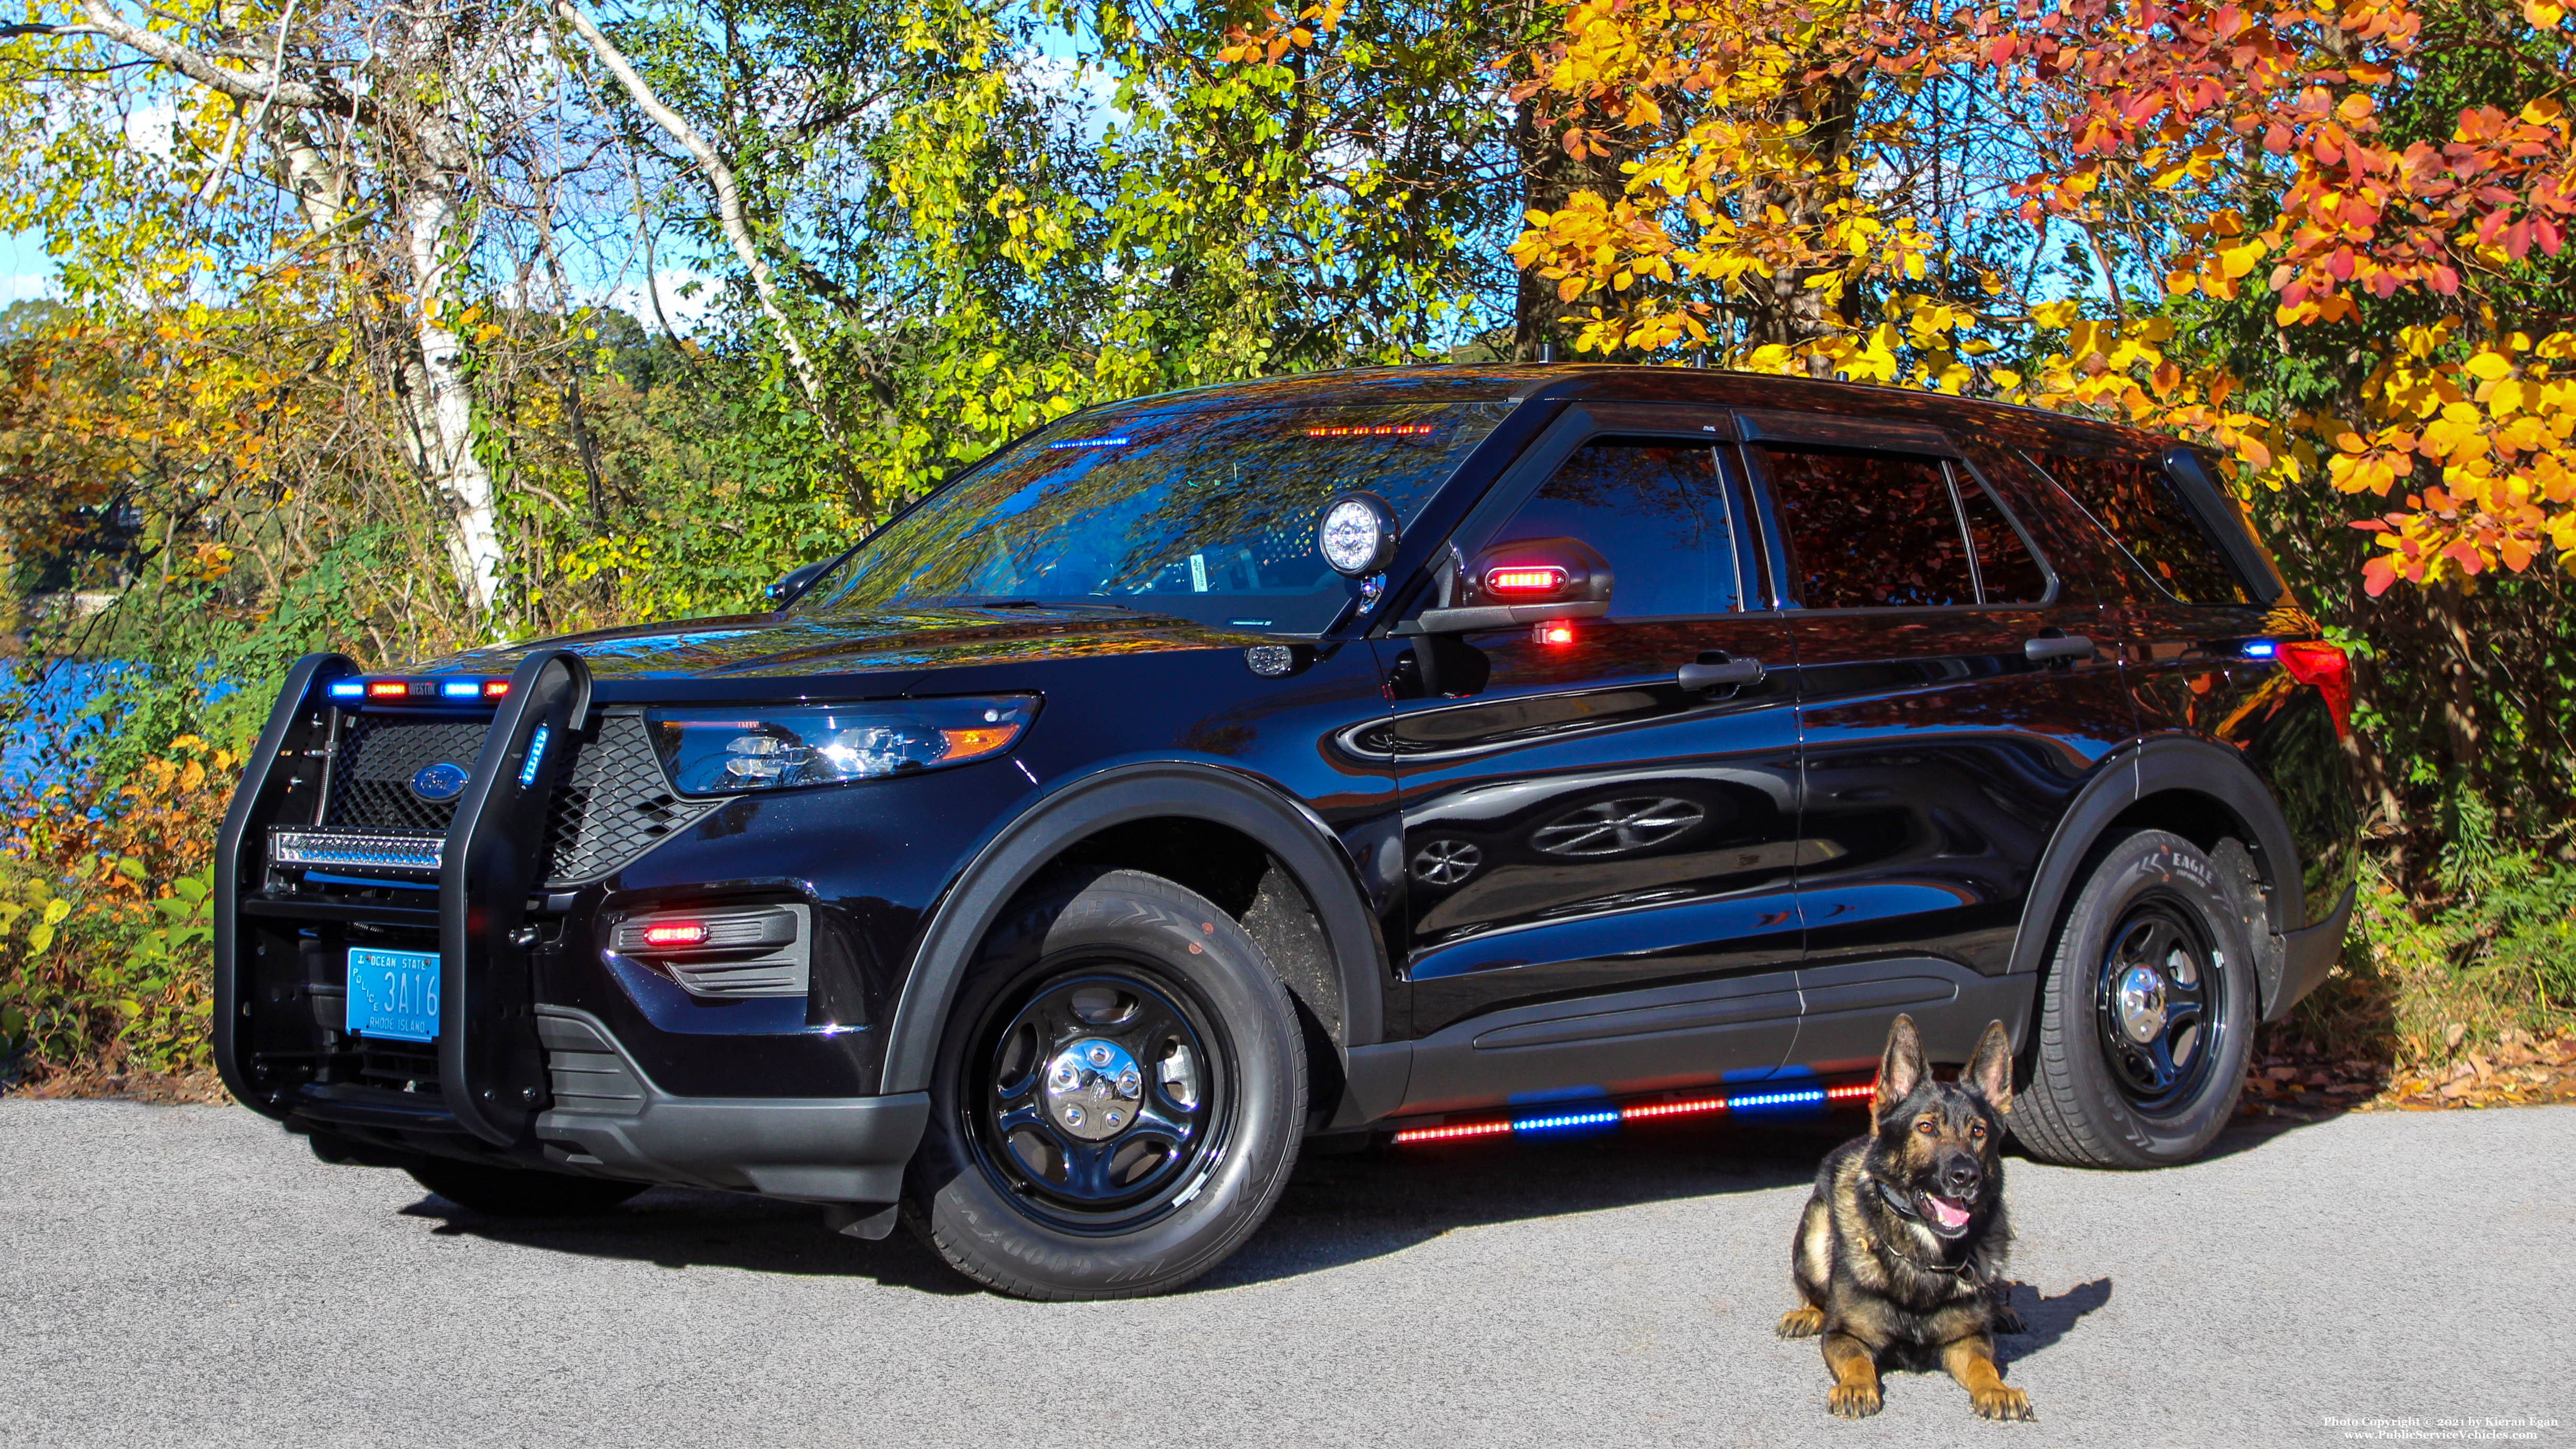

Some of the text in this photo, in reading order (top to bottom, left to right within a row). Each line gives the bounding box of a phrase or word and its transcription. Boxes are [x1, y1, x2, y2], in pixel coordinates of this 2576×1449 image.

[2172, 852, 2214, 885] EAGLE
[370, 956, 426, 971] OCEAN STATE
[353, 968, 380, 1012] POLICE
[384, 971, 438, 1017] 3A16
[370, 1016, 425, 1034] RHODE ISLAND
